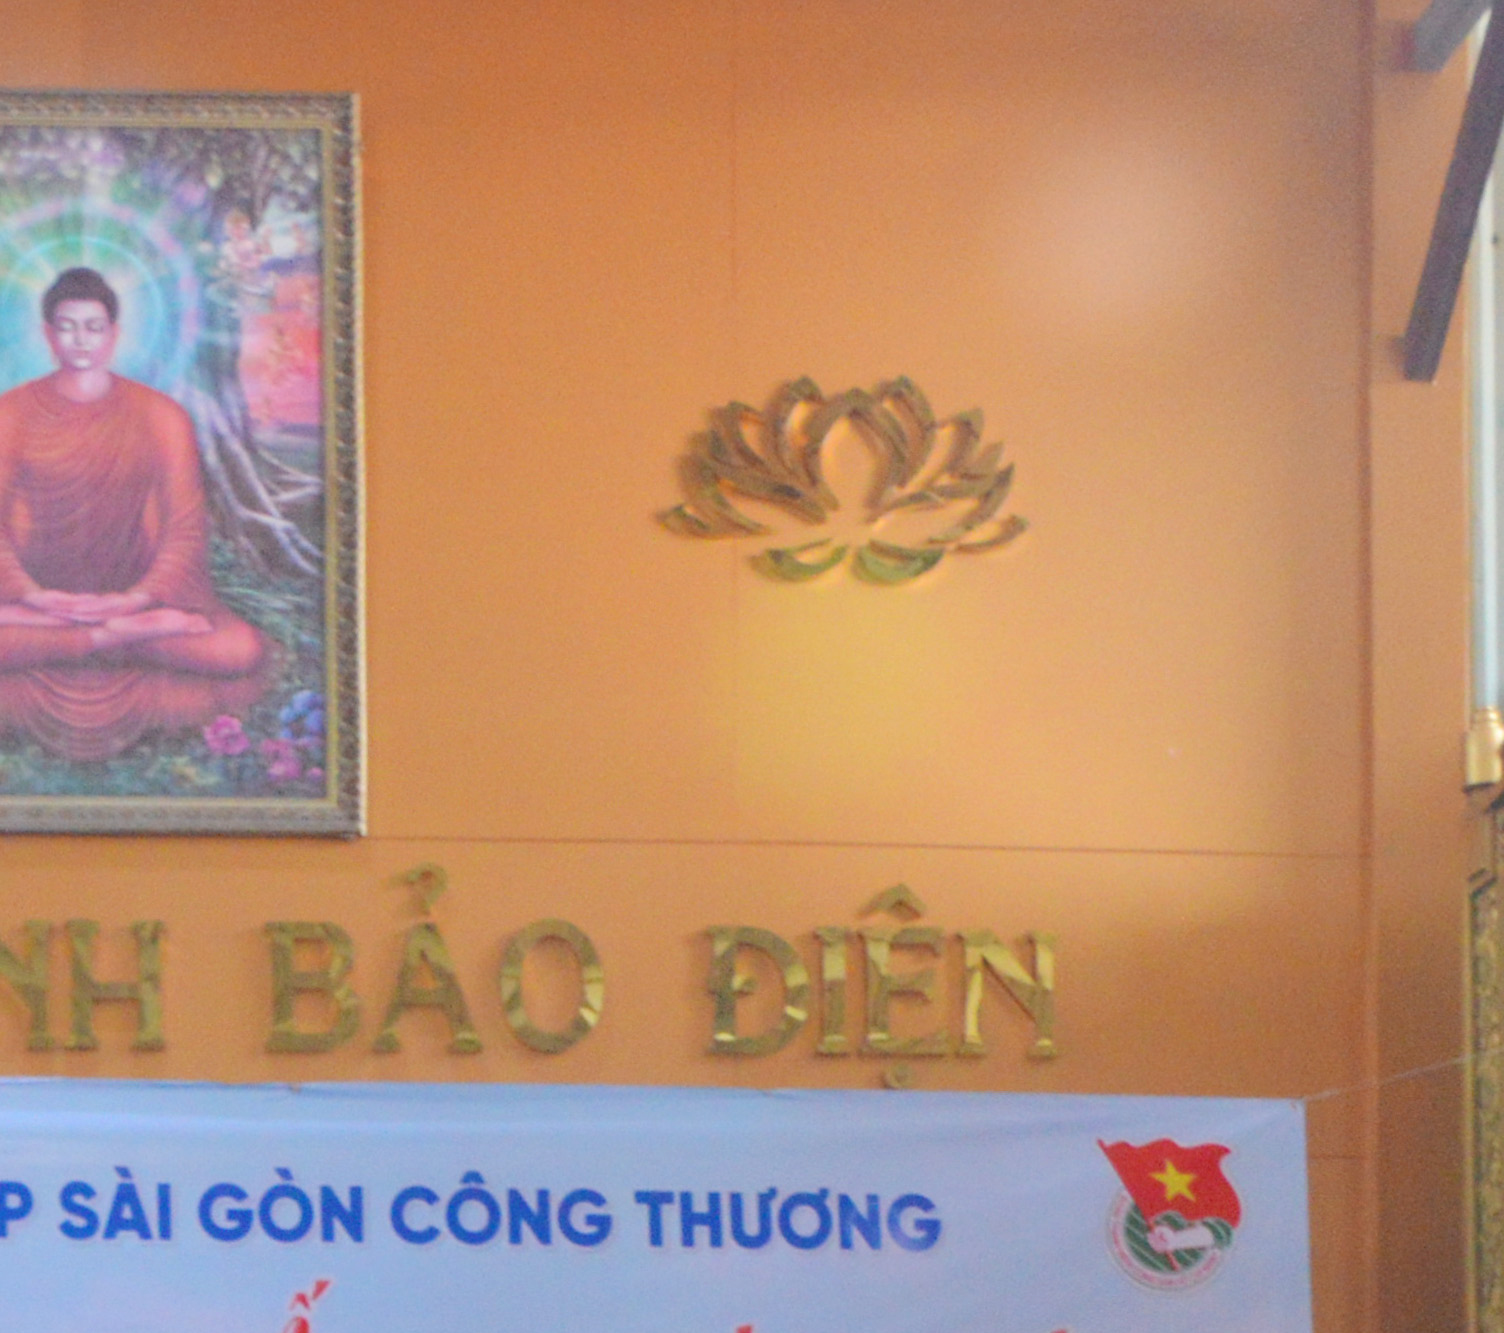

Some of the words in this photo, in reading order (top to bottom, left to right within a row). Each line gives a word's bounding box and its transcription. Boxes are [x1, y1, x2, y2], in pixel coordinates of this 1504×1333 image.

[261, 860, 605, 1057] BẢO
[59, 1166, 172, 1241] SÀI
[197, 1167, 365, 1243] GÒN
[389, 1170, 613, 1247] CÔNG
[633, 1186, 942, 1251] THƯƠNG
